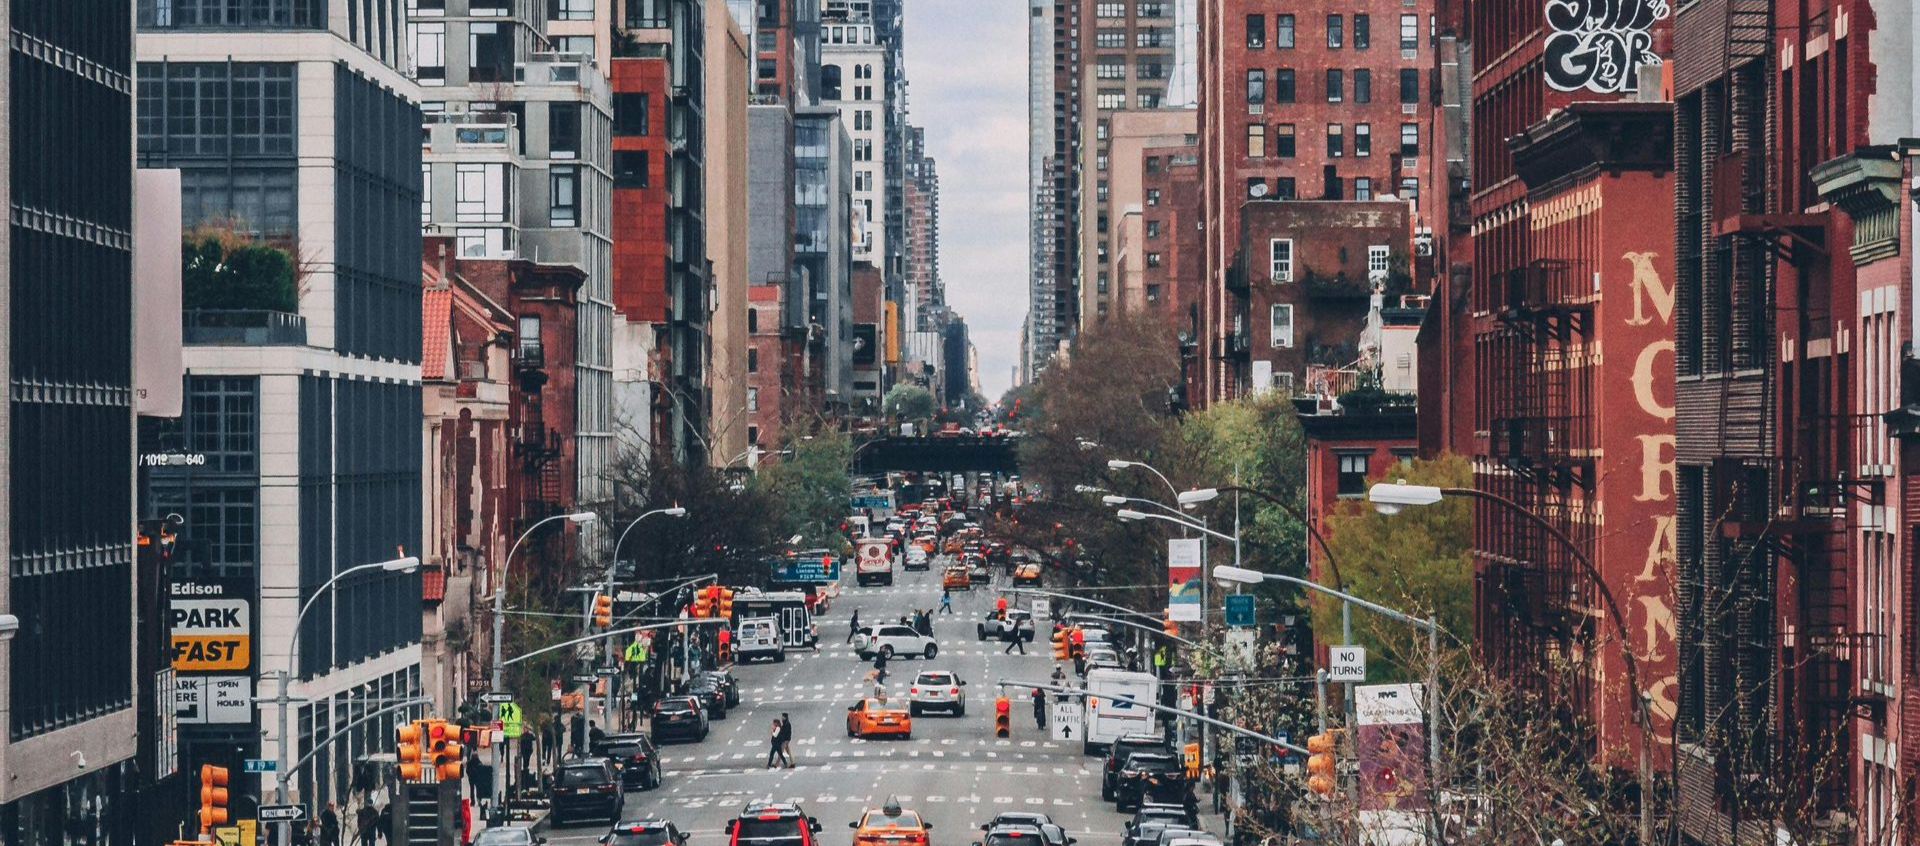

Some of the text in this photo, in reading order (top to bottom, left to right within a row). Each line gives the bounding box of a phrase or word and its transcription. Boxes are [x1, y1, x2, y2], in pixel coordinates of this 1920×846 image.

[171, 582, 223, 595] Edison
[170, 607, 242, 628] PARK
[172, 640, 241, 662] FAST
[1340, 652, 1355, 662] NO
[1332, 666, 1364, 676] TURNS
[176, 680, 198, 690] ARK
[176, 692, 198, 702] ERE
[217, 690, 227, 698] 24
[1378, 691, 1398, 699] NYC
[1060, 705, 1073, 714] ALL
[1054, 715, 1080, 724] TRAFFIC
[247, 762, 255, 770] W
[257, 762, 266, 770] 19
